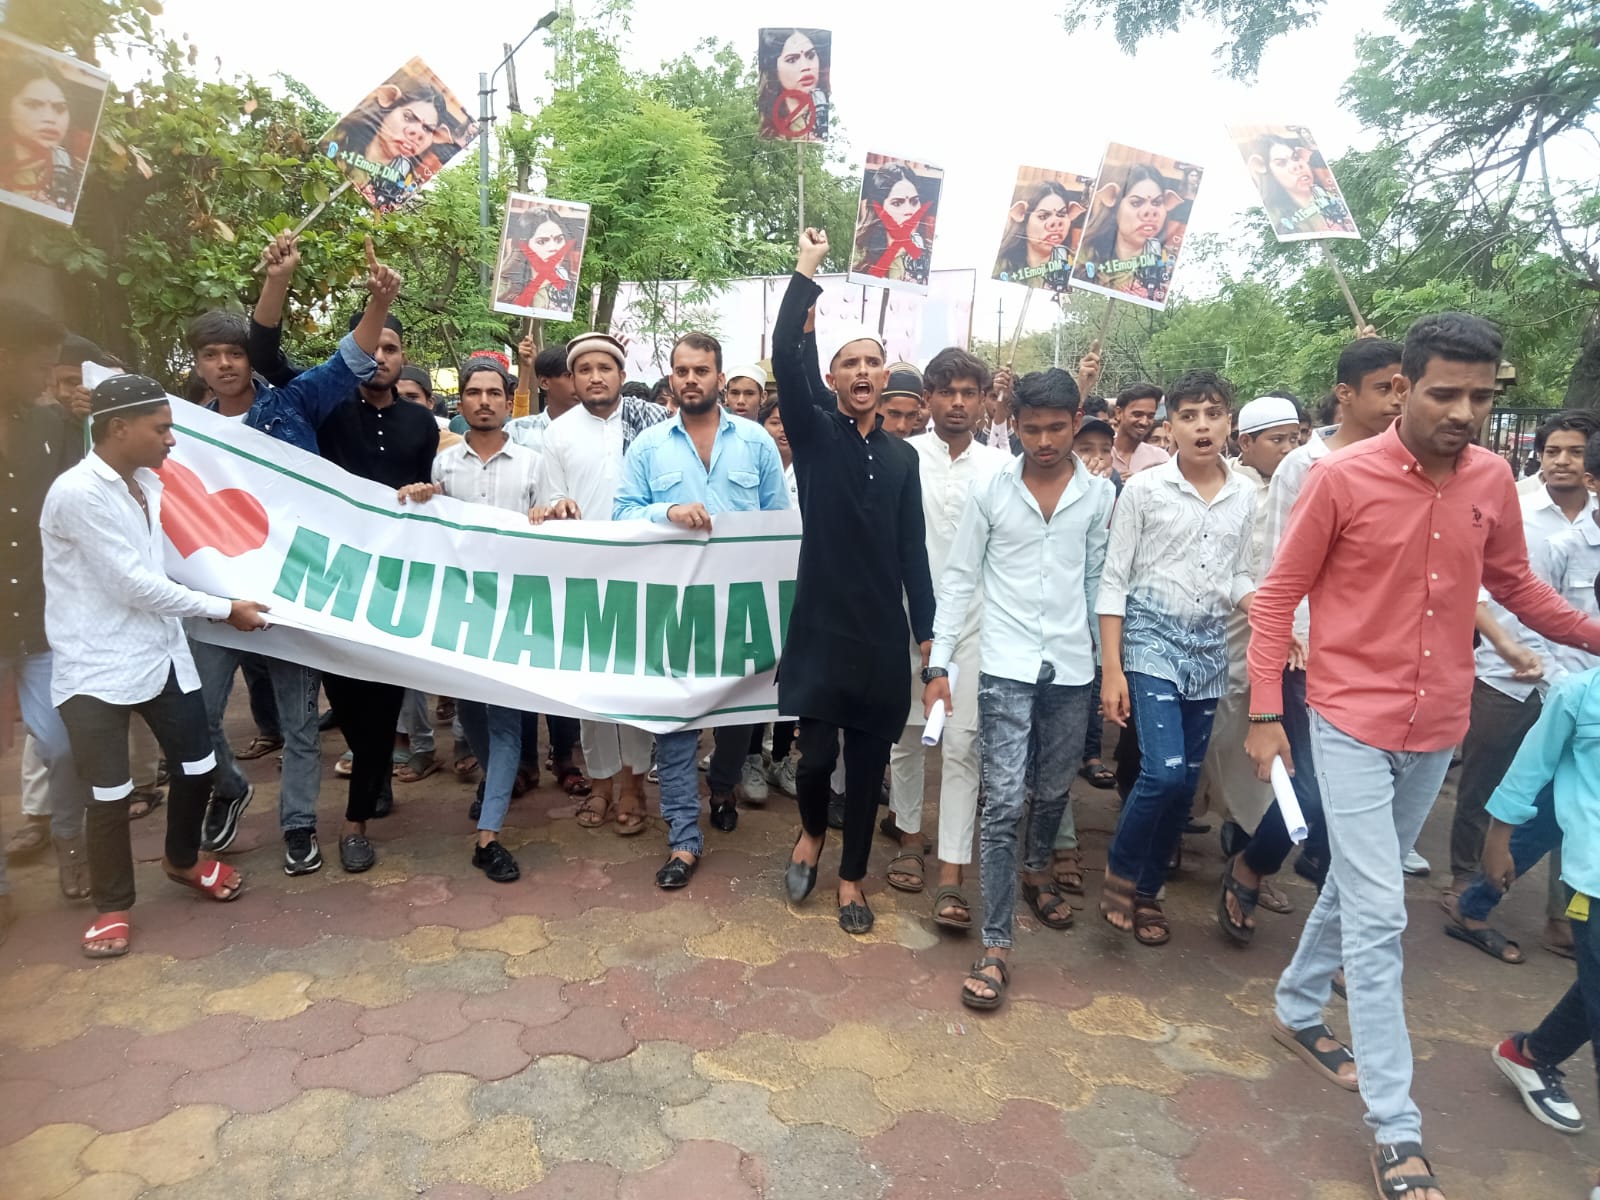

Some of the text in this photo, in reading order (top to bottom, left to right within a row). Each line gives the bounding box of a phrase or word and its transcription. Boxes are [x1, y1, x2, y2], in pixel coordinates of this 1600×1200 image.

[340, 150, 355, 165] +1
[381, 166, 399, 183] DM
[1011, 268, 1024, 280] +1
[1048, 259, 1063, 272] DM
[1098, 261, 1112, 273] +1
[1140, 254, 1156, 267] DM
